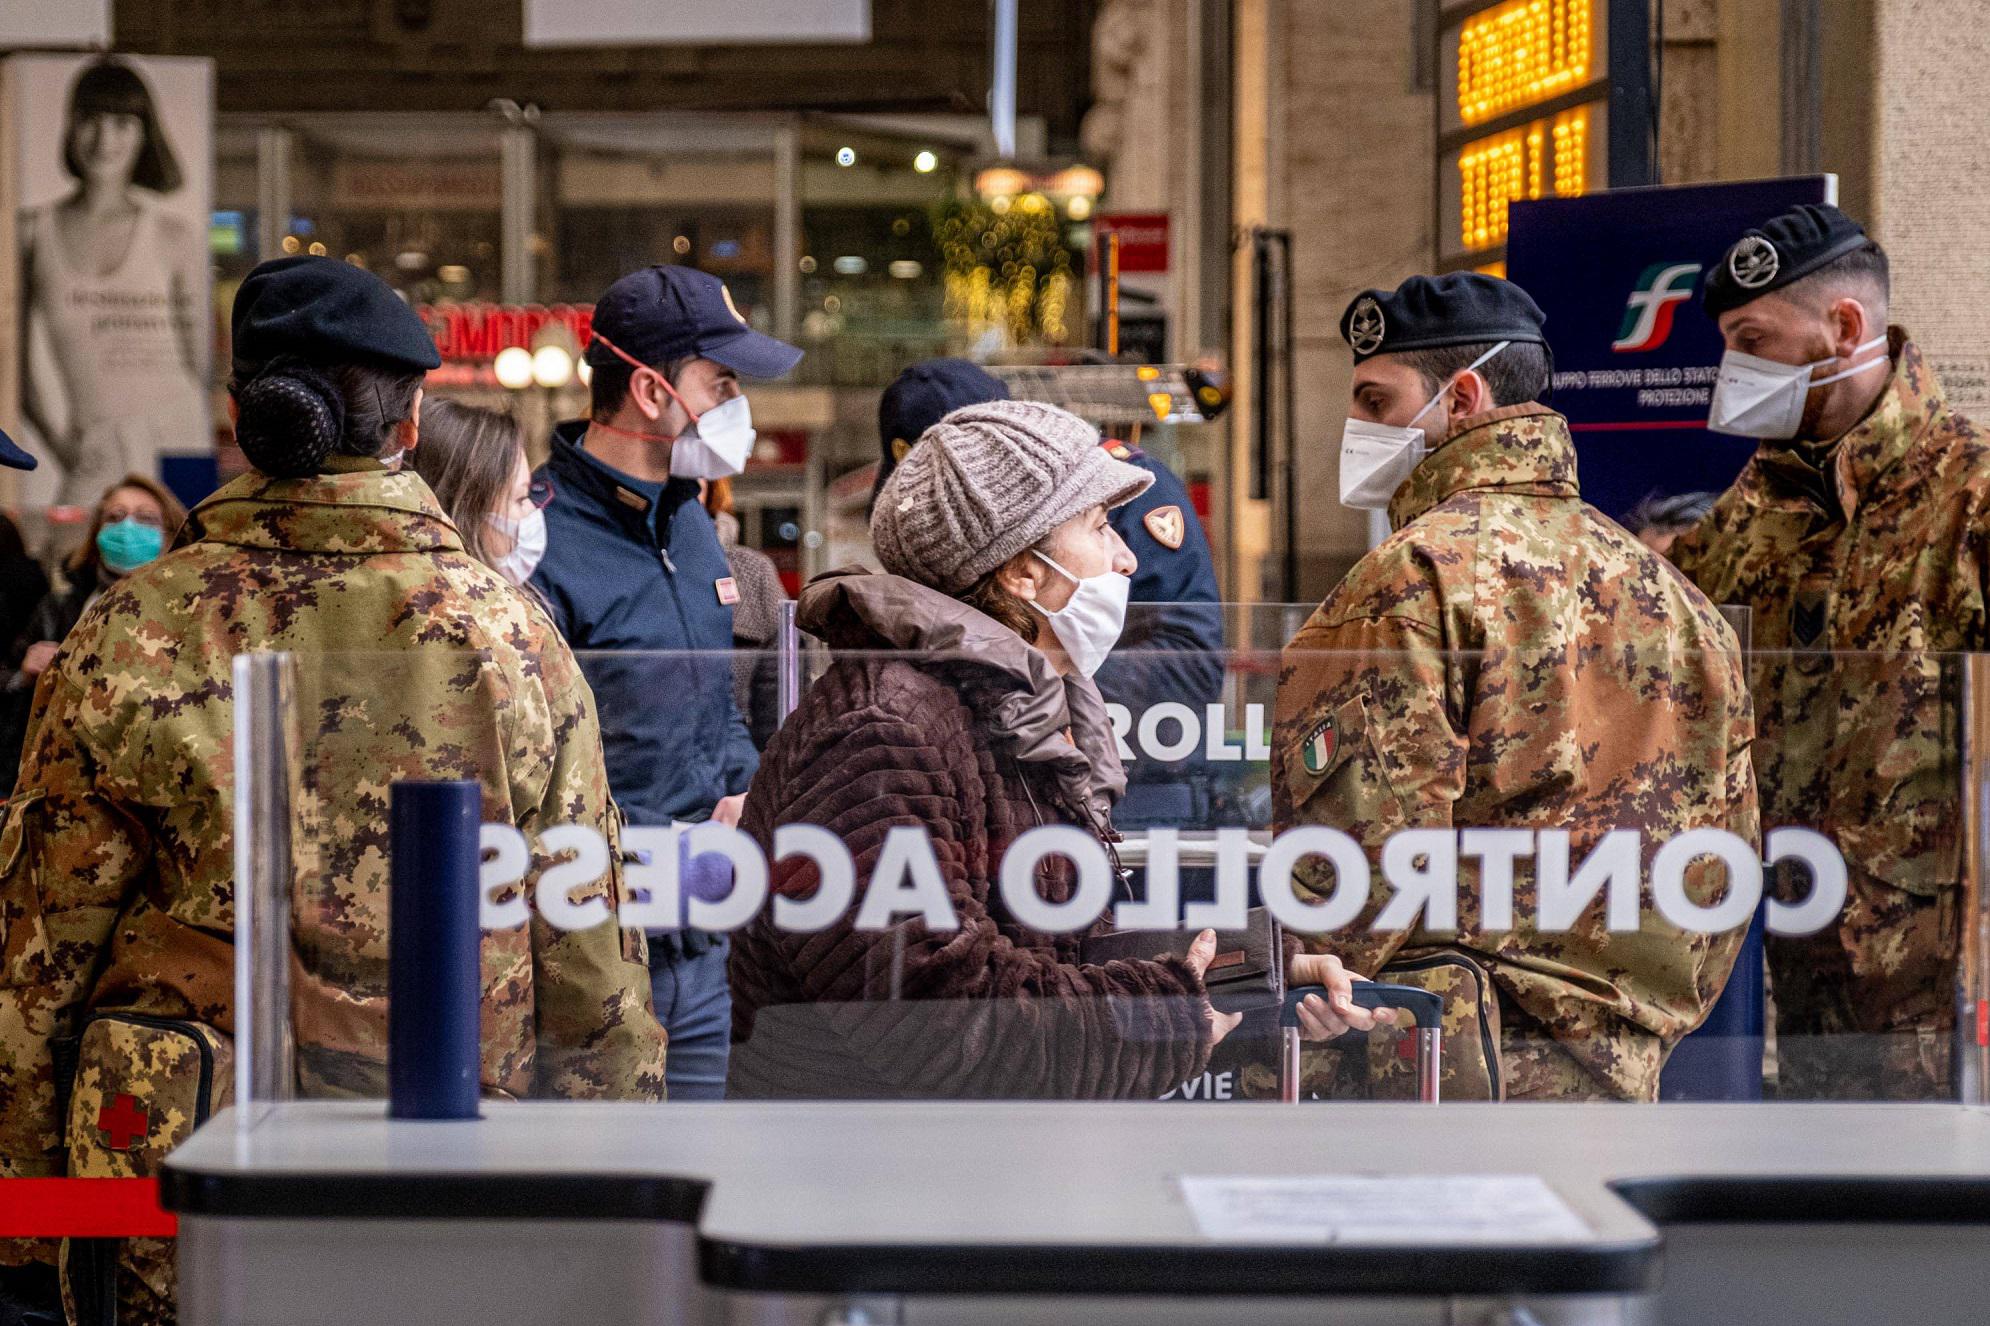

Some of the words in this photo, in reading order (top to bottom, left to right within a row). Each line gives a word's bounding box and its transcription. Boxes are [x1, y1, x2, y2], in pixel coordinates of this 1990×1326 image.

[1644, 367, 1682, 387] DELLO
[1638, 387, 1711, 407] PROTEZIONE
[1305, 721, 1332, 747] ITALIA
[1158, 1071, 1232, 1100] VIE
